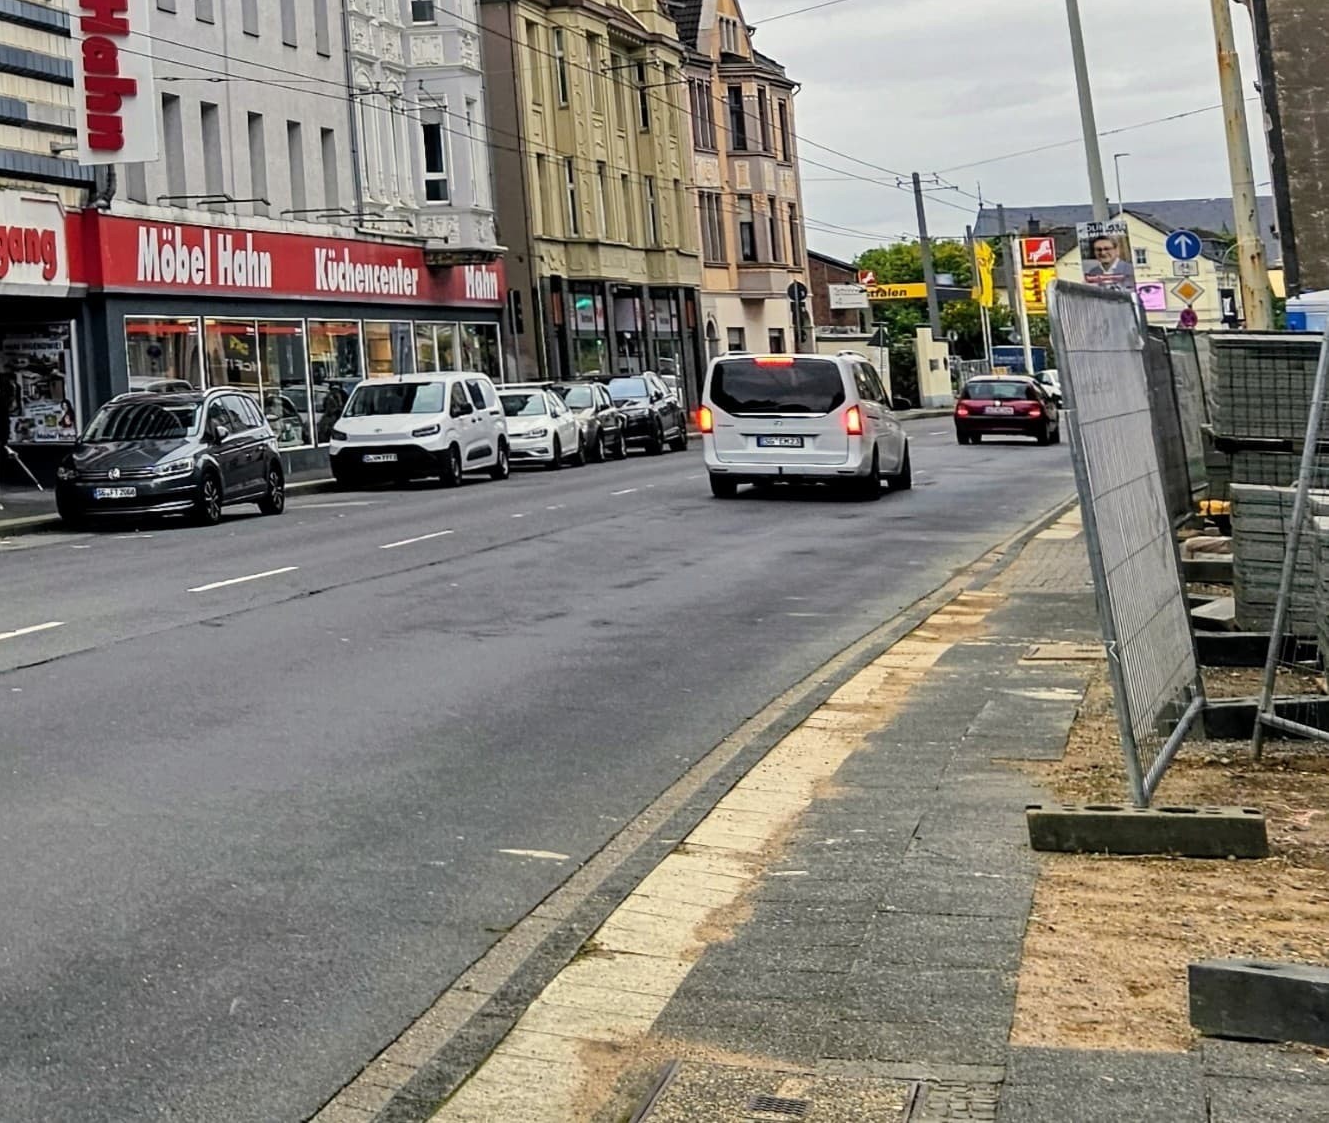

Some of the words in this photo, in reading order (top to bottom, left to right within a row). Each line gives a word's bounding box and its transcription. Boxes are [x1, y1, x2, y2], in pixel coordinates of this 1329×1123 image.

[137, 226, 211, 285] Möbel
[217, 233, 272, 289] Hahn
[314, 247, 418, 296] Küchencenter
[465, 265, 498, 300] Hahn
